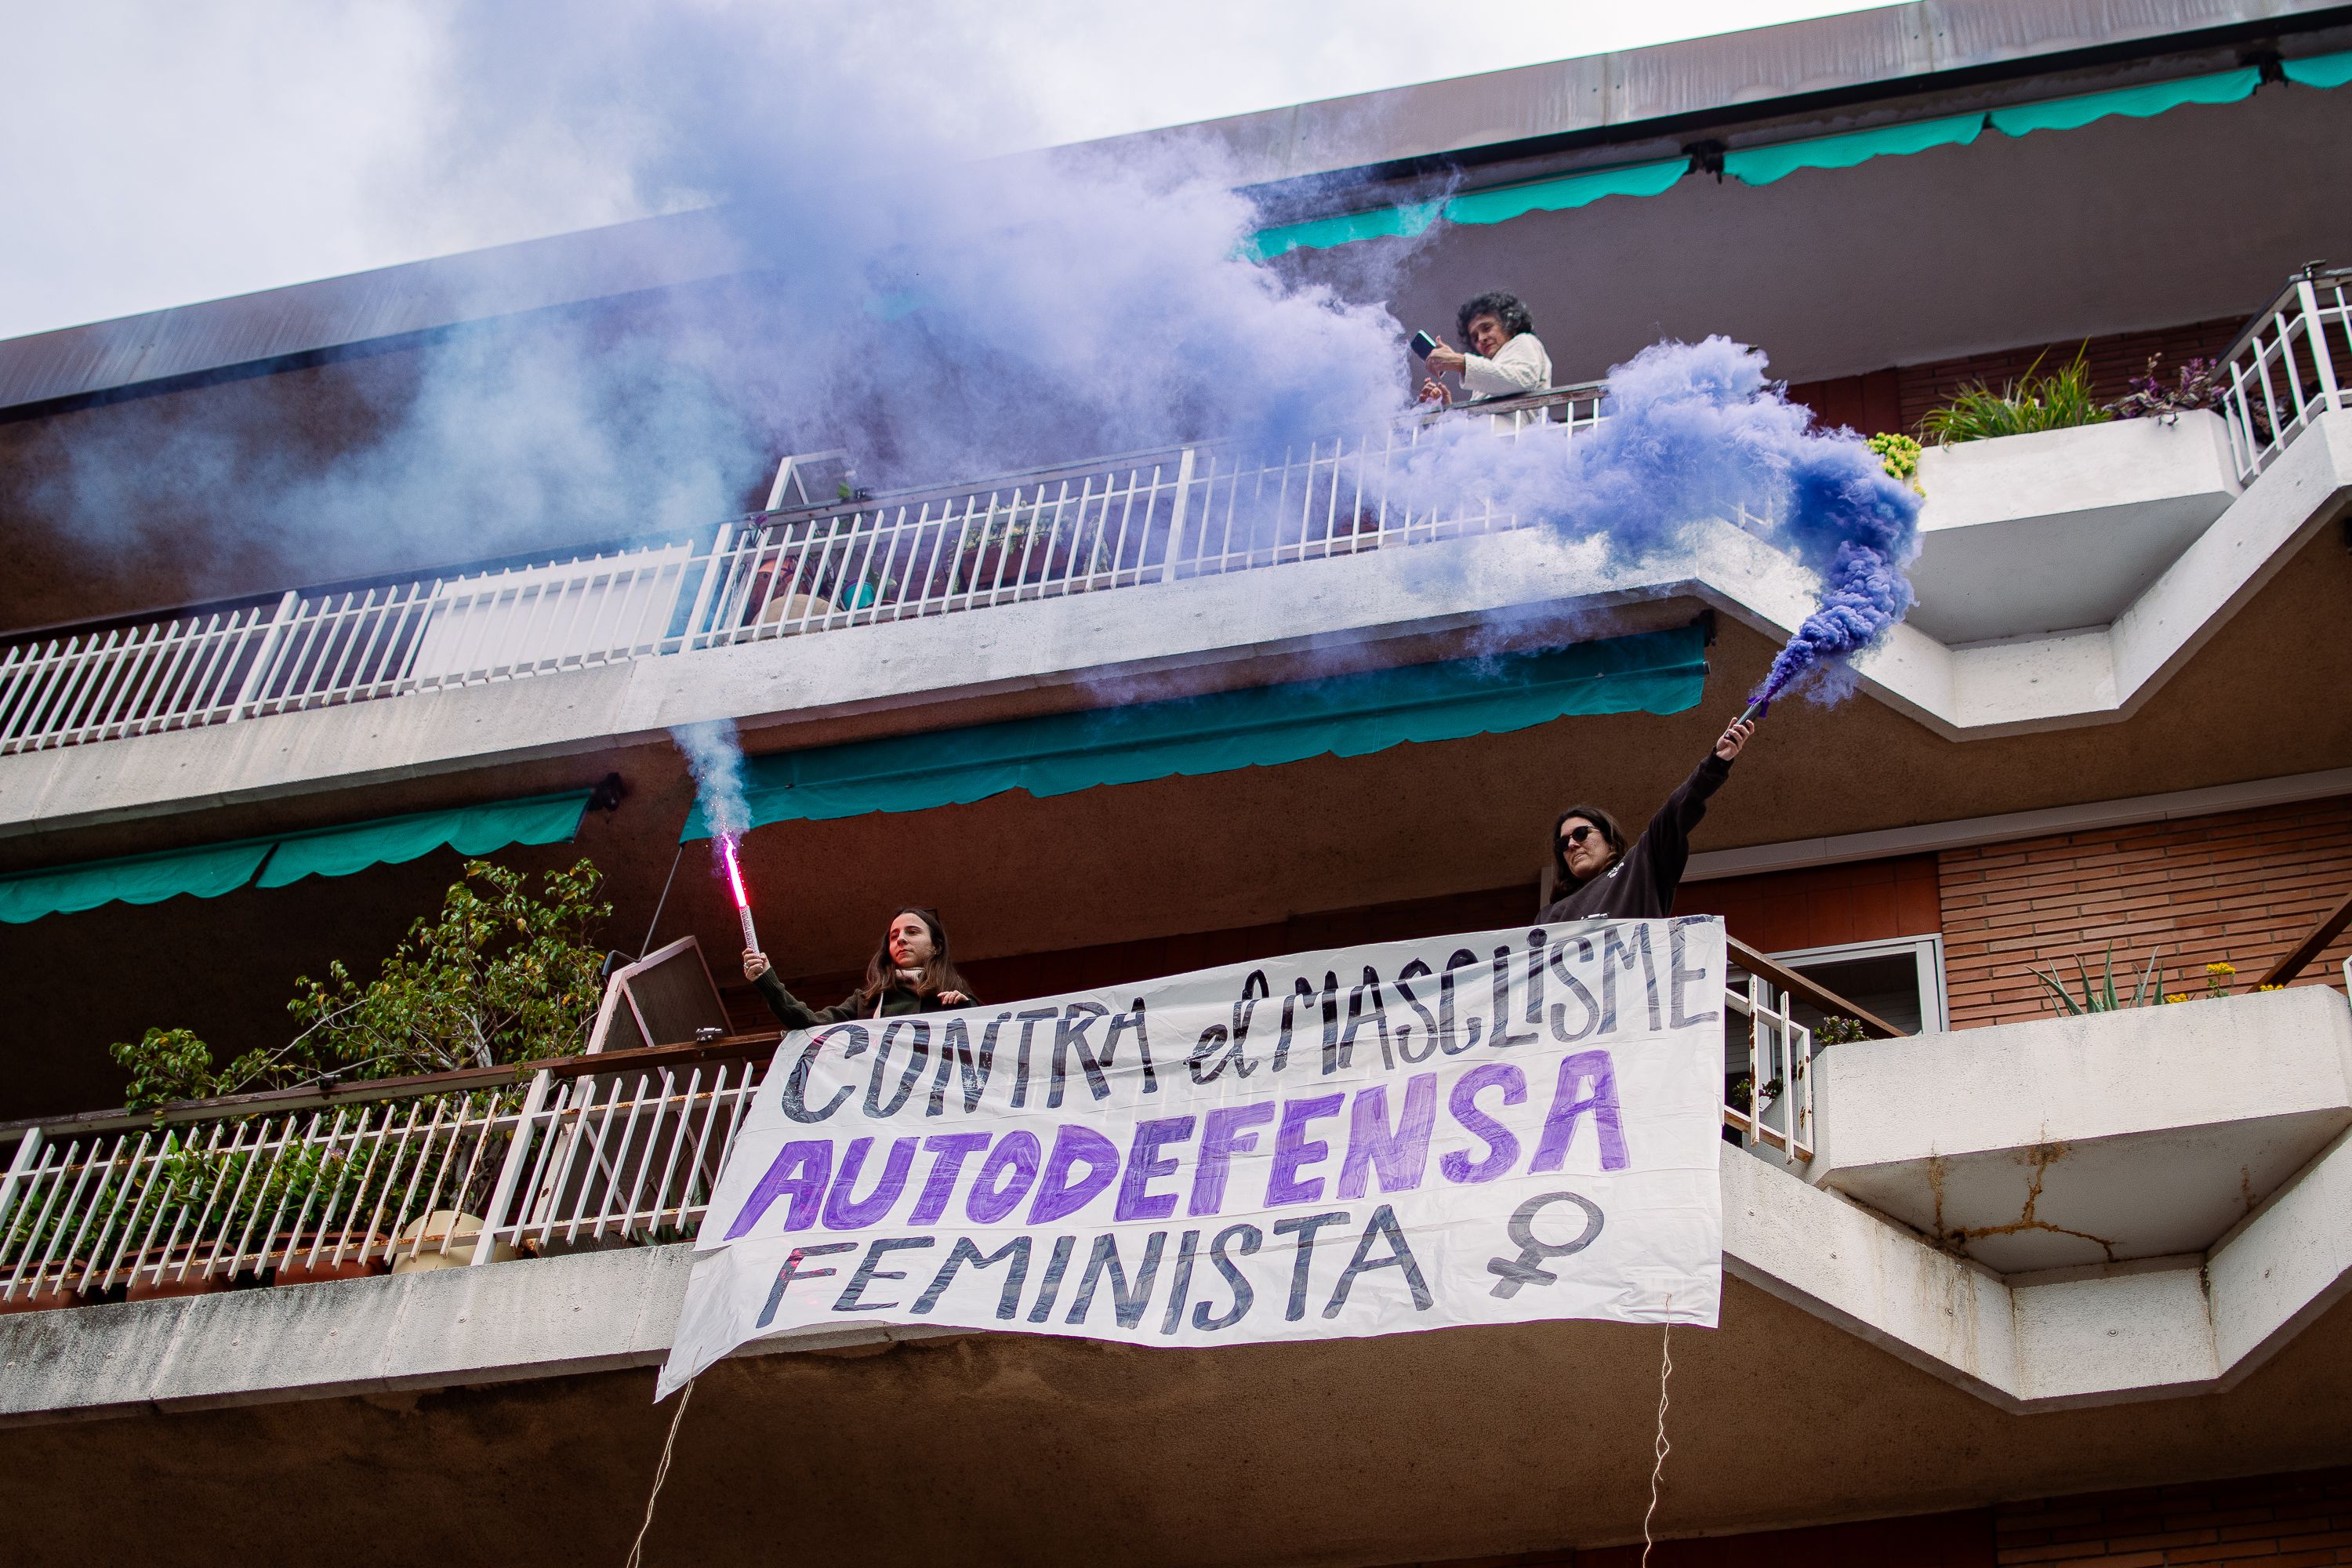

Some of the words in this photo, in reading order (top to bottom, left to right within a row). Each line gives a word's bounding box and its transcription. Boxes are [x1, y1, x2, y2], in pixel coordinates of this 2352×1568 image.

[782, 997, 1157, 1123] CONTRA
[1183, 970, 1269, 1085] el
[723, 1049, 1630, 1240] AUTODEFENSA
[756, 1204, 1433, 1334] FEMINISTA
